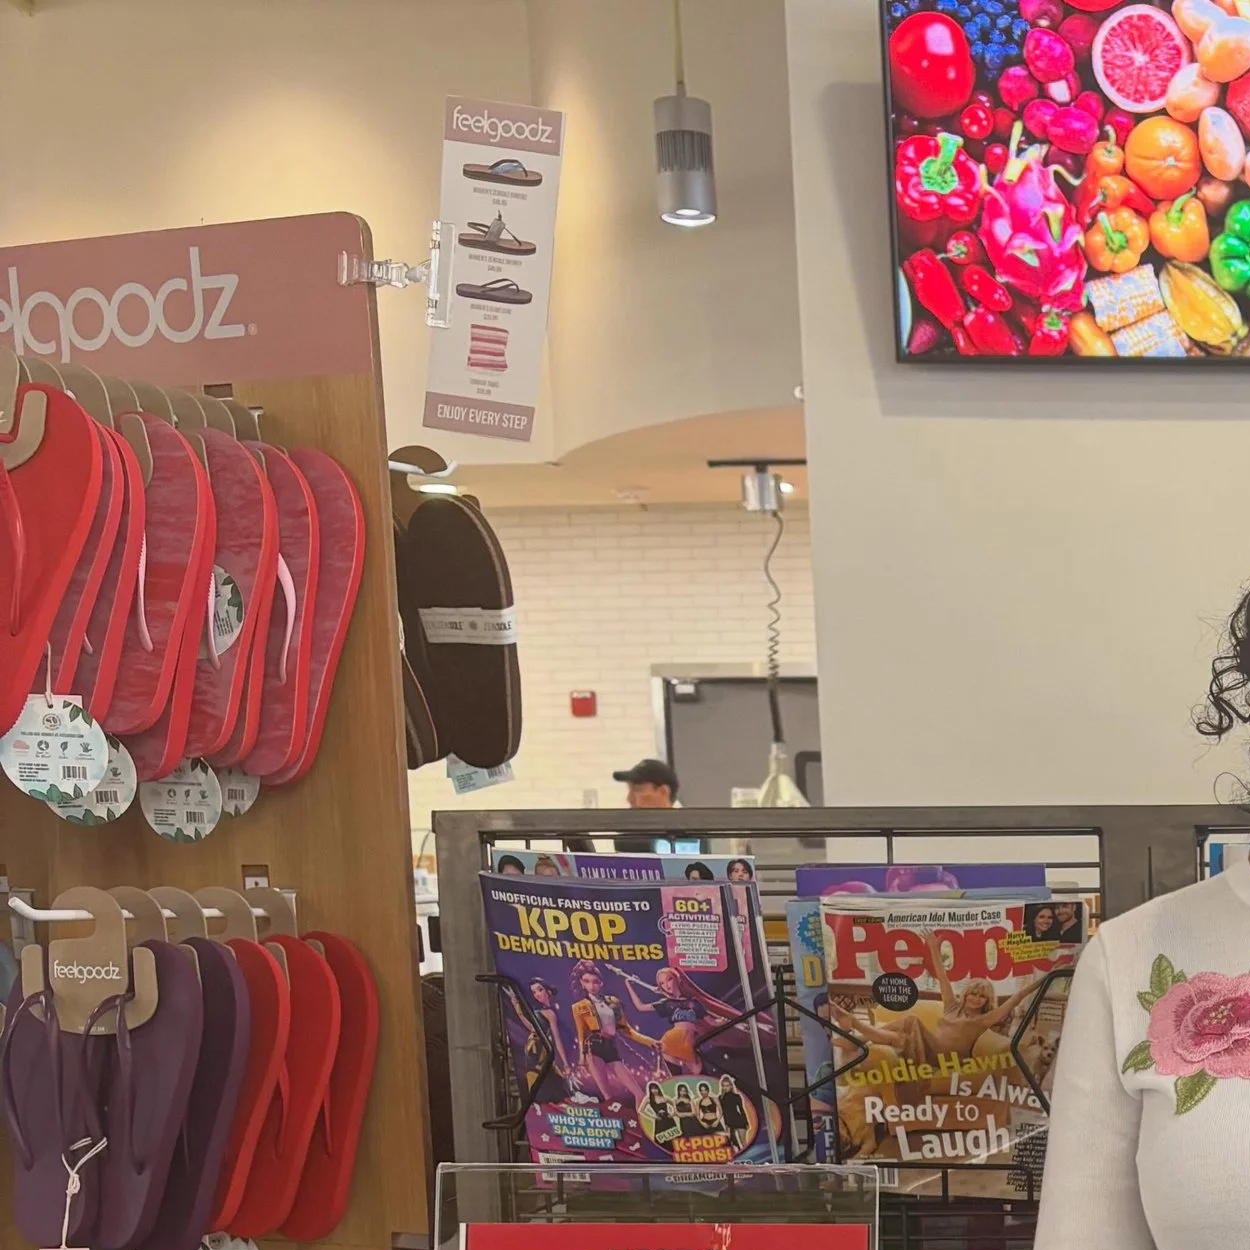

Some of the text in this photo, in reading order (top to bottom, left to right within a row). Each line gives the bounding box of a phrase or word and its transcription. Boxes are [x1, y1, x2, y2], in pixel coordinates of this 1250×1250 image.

[452, 105, 554, 144] feelgoodz
[437, 403, 528, 430] ENJOY EVERY STEP
[491, 890, 650, 912] UNOFFICIAL FAN'S GUIDE TO
[674, 899, 710, 912] 60+
[514, 903, 627, 942] KPOP
[888, 911, 927, 922] American
[928, 911, 945, 922] Idol
[949, 910, 979, 922] Murder
[980, 910, 1001, 921] Case
[494, 931, 563, 958] DEMON
[564, 939, 664, 962] HUNTERS
[53, 960, 122, 984] feelgoodz
[898, 986, 912, 995] THE
[845, 1053, 933, 1088] Goldie
[950, 1072, 972, 1097] Is
[589, 1117, 621, 1128] YOUR
[864, 1096, 980, 1128] Ready to
[896, 1114, 1010, 1164] Laugh
